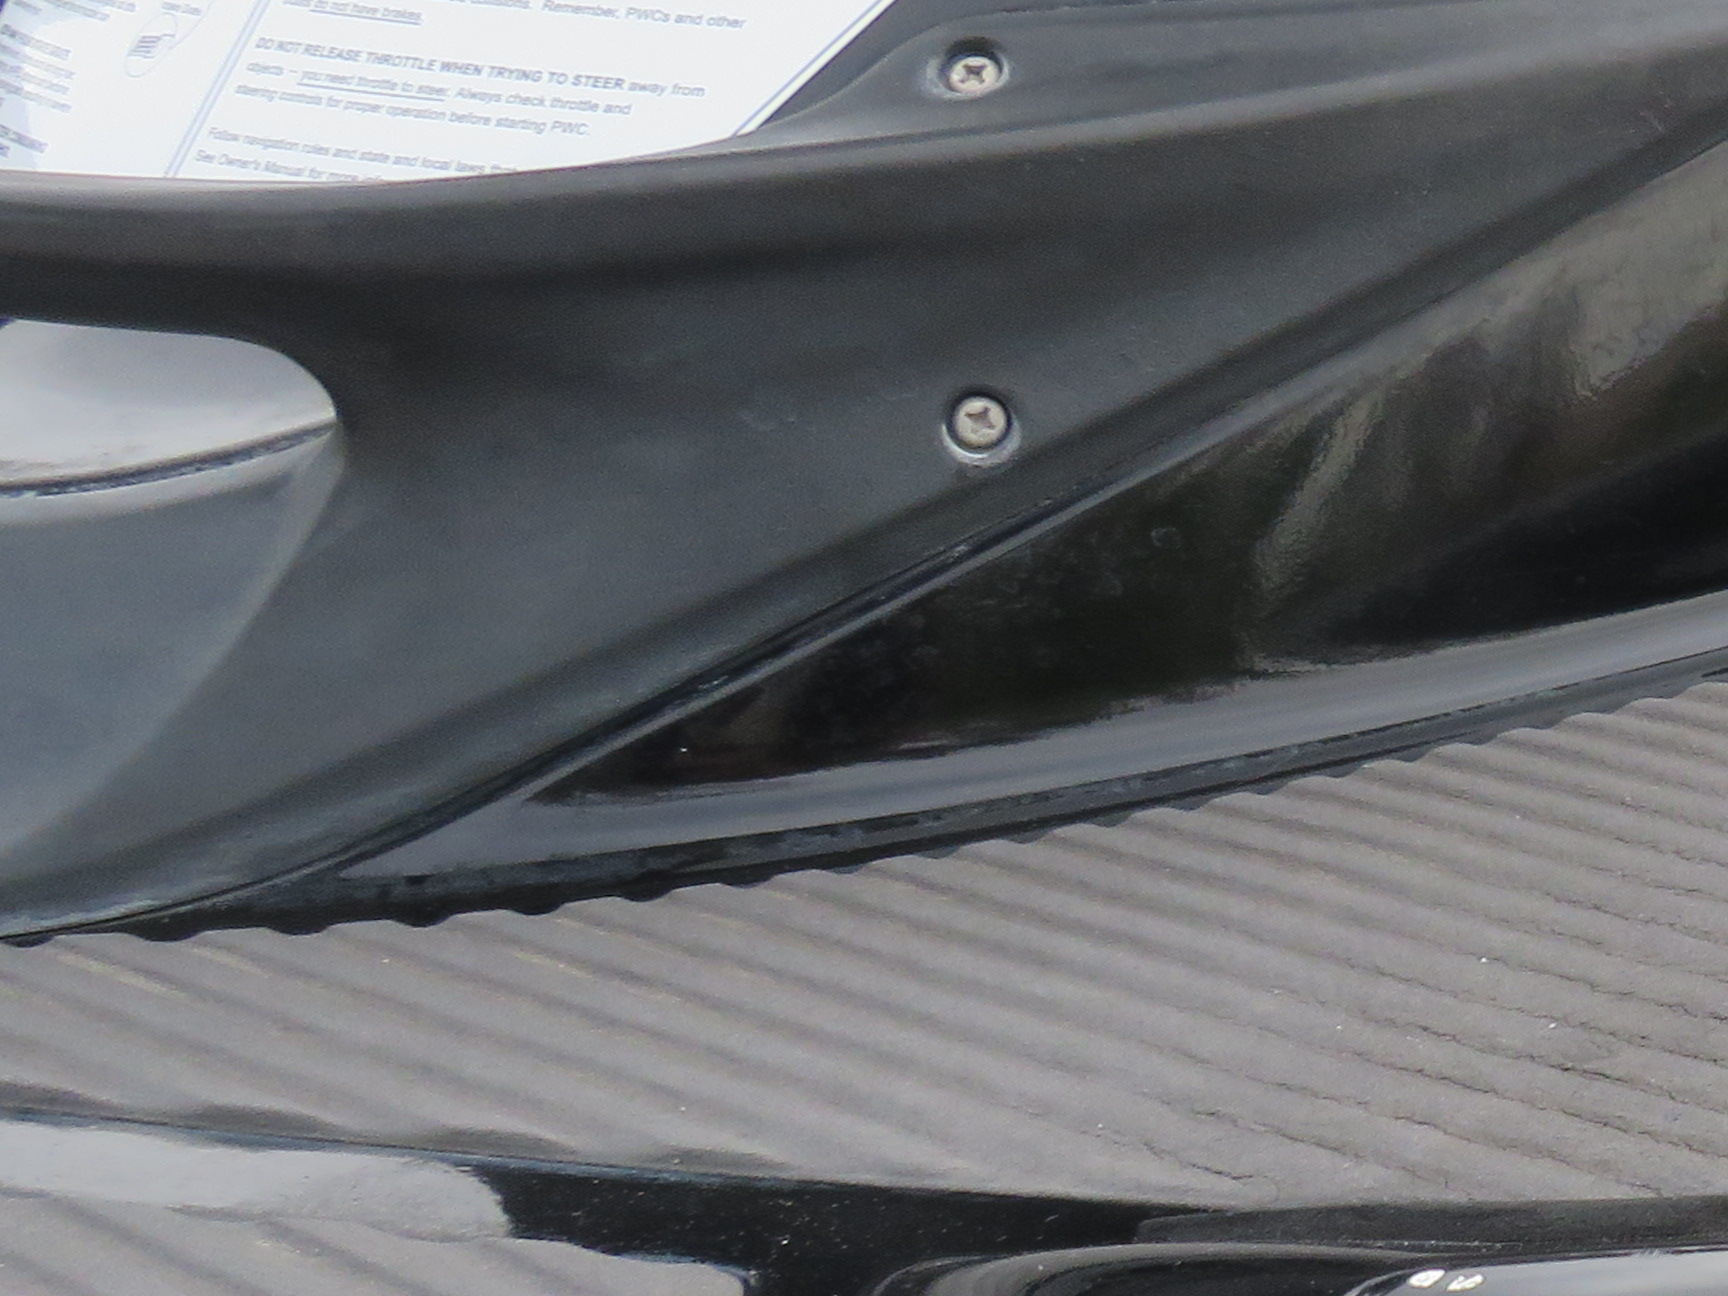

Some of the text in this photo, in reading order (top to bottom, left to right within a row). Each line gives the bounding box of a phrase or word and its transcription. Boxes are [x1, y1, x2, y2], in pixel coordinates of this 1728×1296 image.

[673, 13, 704, 25] and
[706, 15, 746, 28] other
[301, 43, 363, 62] RELEASE
[365, 51, 437, 71] THROTTLE
[439, 60, 484, 76] WHEN
[488, 65, 543, 82] TRYING
[547, 71, 568, 85] TO
[570, 74, 625, 90] STEER
[627, 81, 667, 95] away
[670, 82, 705, 96] from
